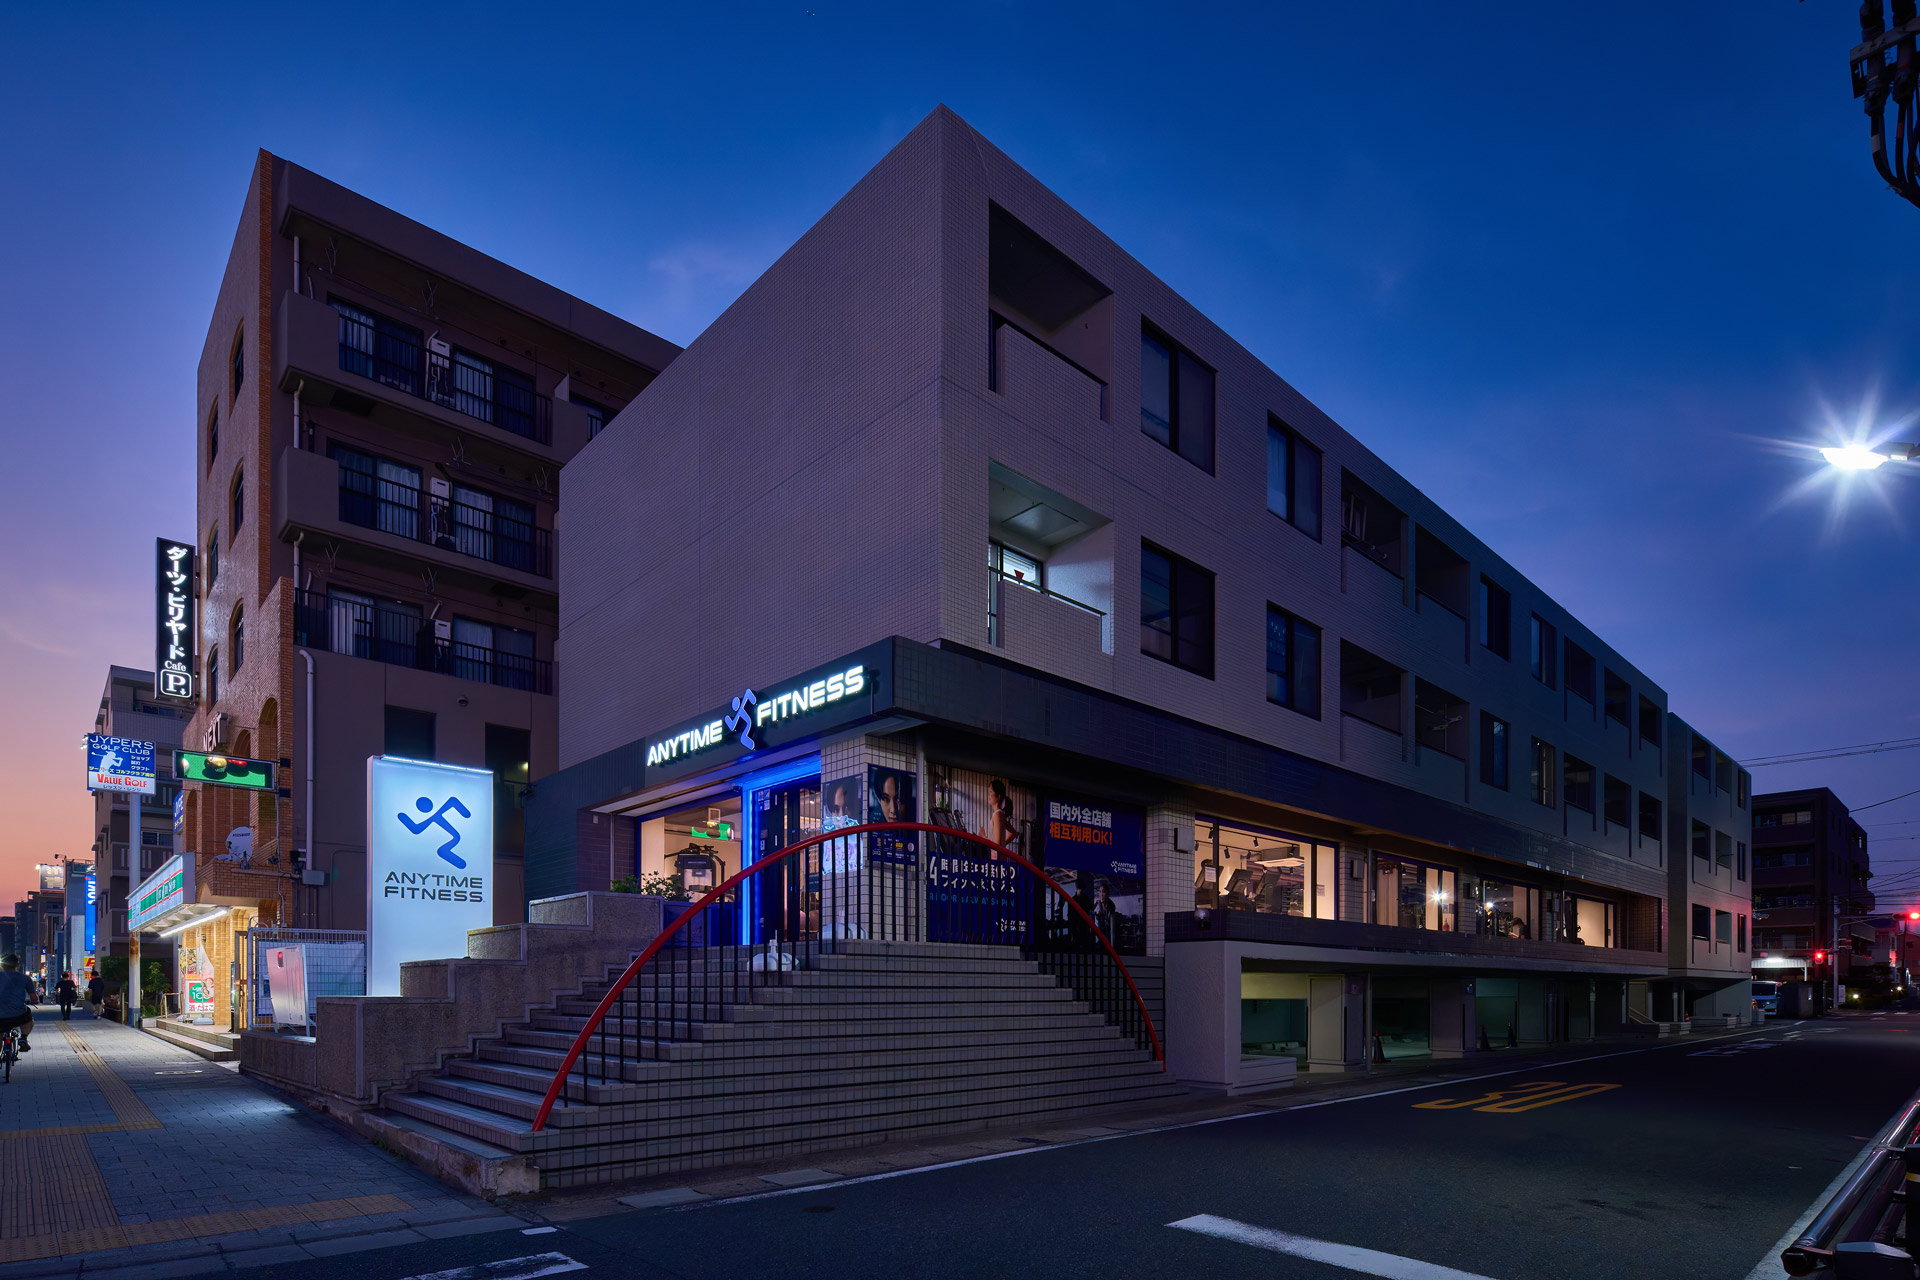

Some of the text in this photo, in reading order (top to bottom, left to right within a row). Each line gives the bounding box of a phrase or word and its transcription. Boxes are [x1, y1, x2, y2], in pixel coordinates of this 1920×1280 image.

[166, 546, 188, 659] ダーツ・ビリヤード
[165, 660, 187, 672] Cafe
[166, 673, 186, 692] P
[646, 665, 863, 767] ANYTIME FITNESS
[203, 712, 222, 752] NEXT
[90, 735, 154, 750] JYPER'S
[92, 743, 151, 756] GOLF CLUB
[97, 773, 147, 788] VALUE GOLF
[1049, 801, 1112, 829] 国内外全店舗
[1049, 820, 1113, 846] 相互利用OK!
[384, 871, 483, 889] ANYTIME
[384, 886, 483, 903] FITNESS
[1410, 1081, 1625, 1113] 30
